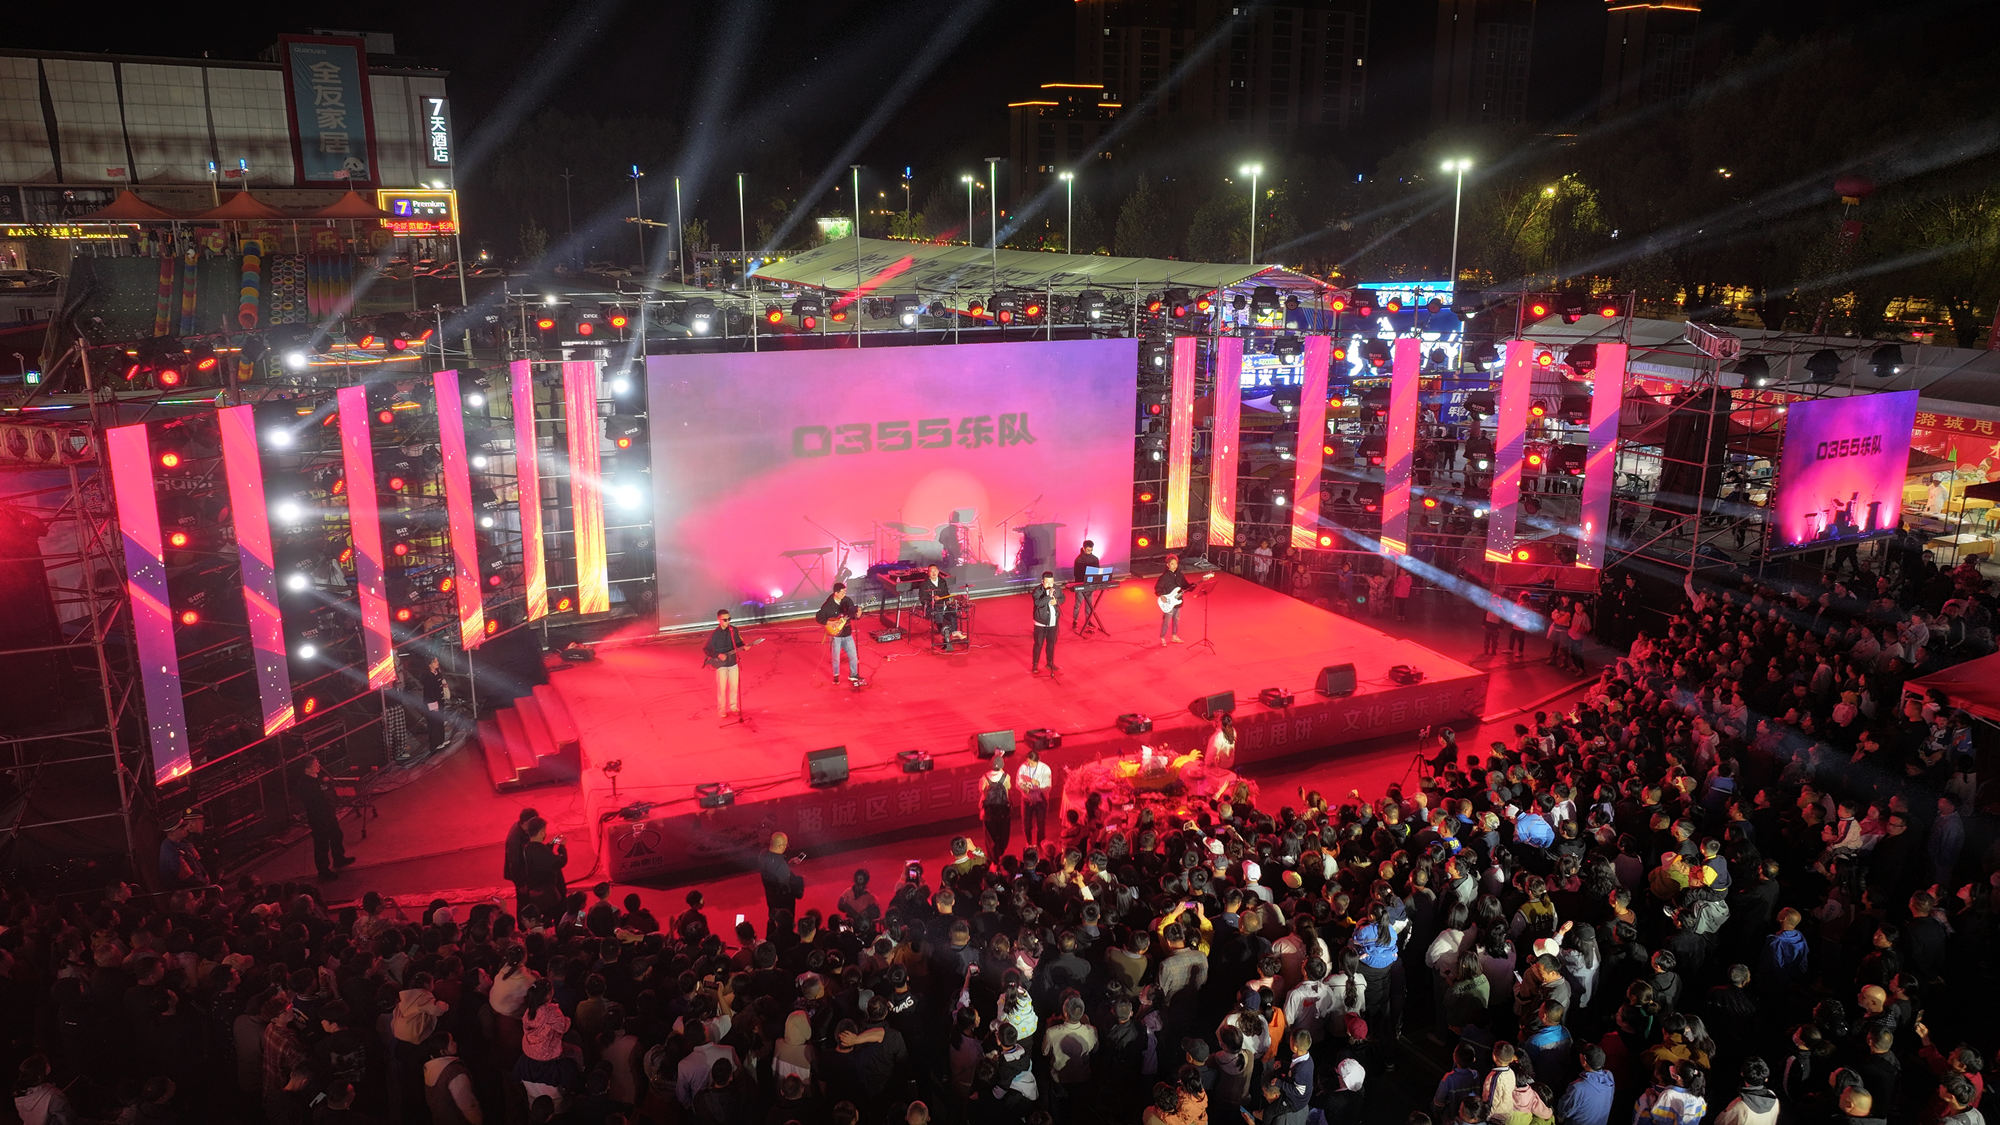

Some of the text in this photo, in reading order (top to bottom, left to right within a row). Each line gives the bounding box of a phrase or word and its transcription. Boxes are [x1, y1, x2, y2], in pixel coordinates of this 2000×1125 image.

[310, 61, 350, 154] 全友家居
[428, 98, 449, 162] 7天酒店
[793, 412, 1037, 458] 0355乐队
[1916, 412, 1994, 435] 潞城甩
[1816, 434, 1882, 460] 0355乐队
